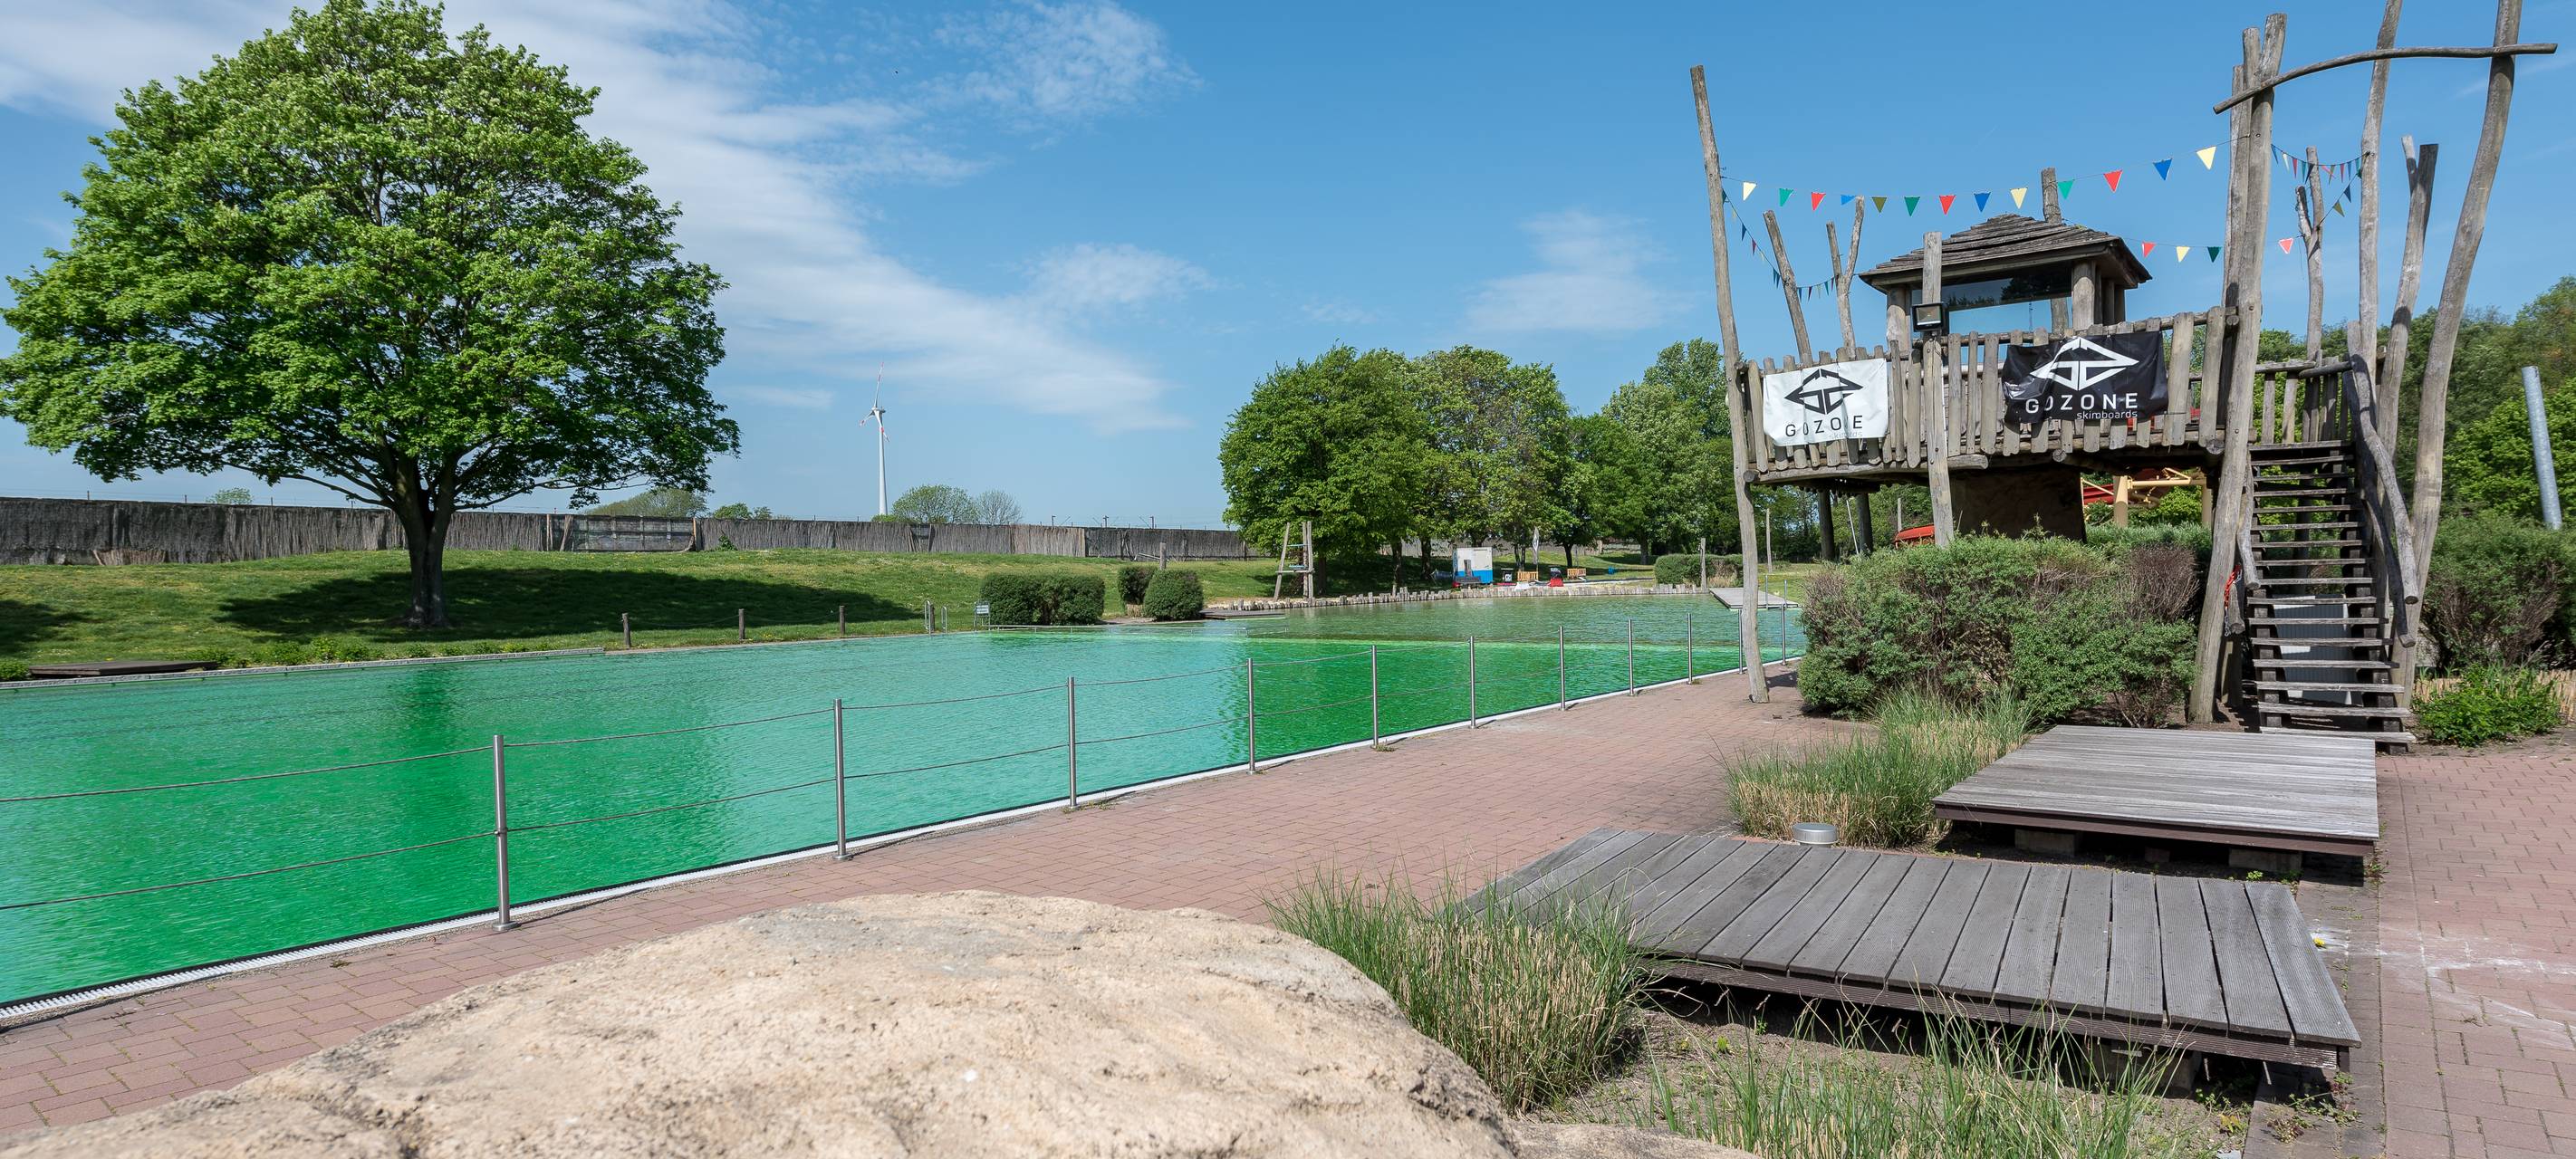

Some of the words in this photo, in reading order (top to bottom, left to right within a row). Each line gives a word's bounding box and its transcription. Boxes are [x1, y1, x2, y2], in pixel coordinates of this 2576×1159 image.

[2025, 392, 2138, 414] GOZONE
[2076, 409, 2138, 420] skimboards
[1785, 415, 1863, 437] GOZOE
